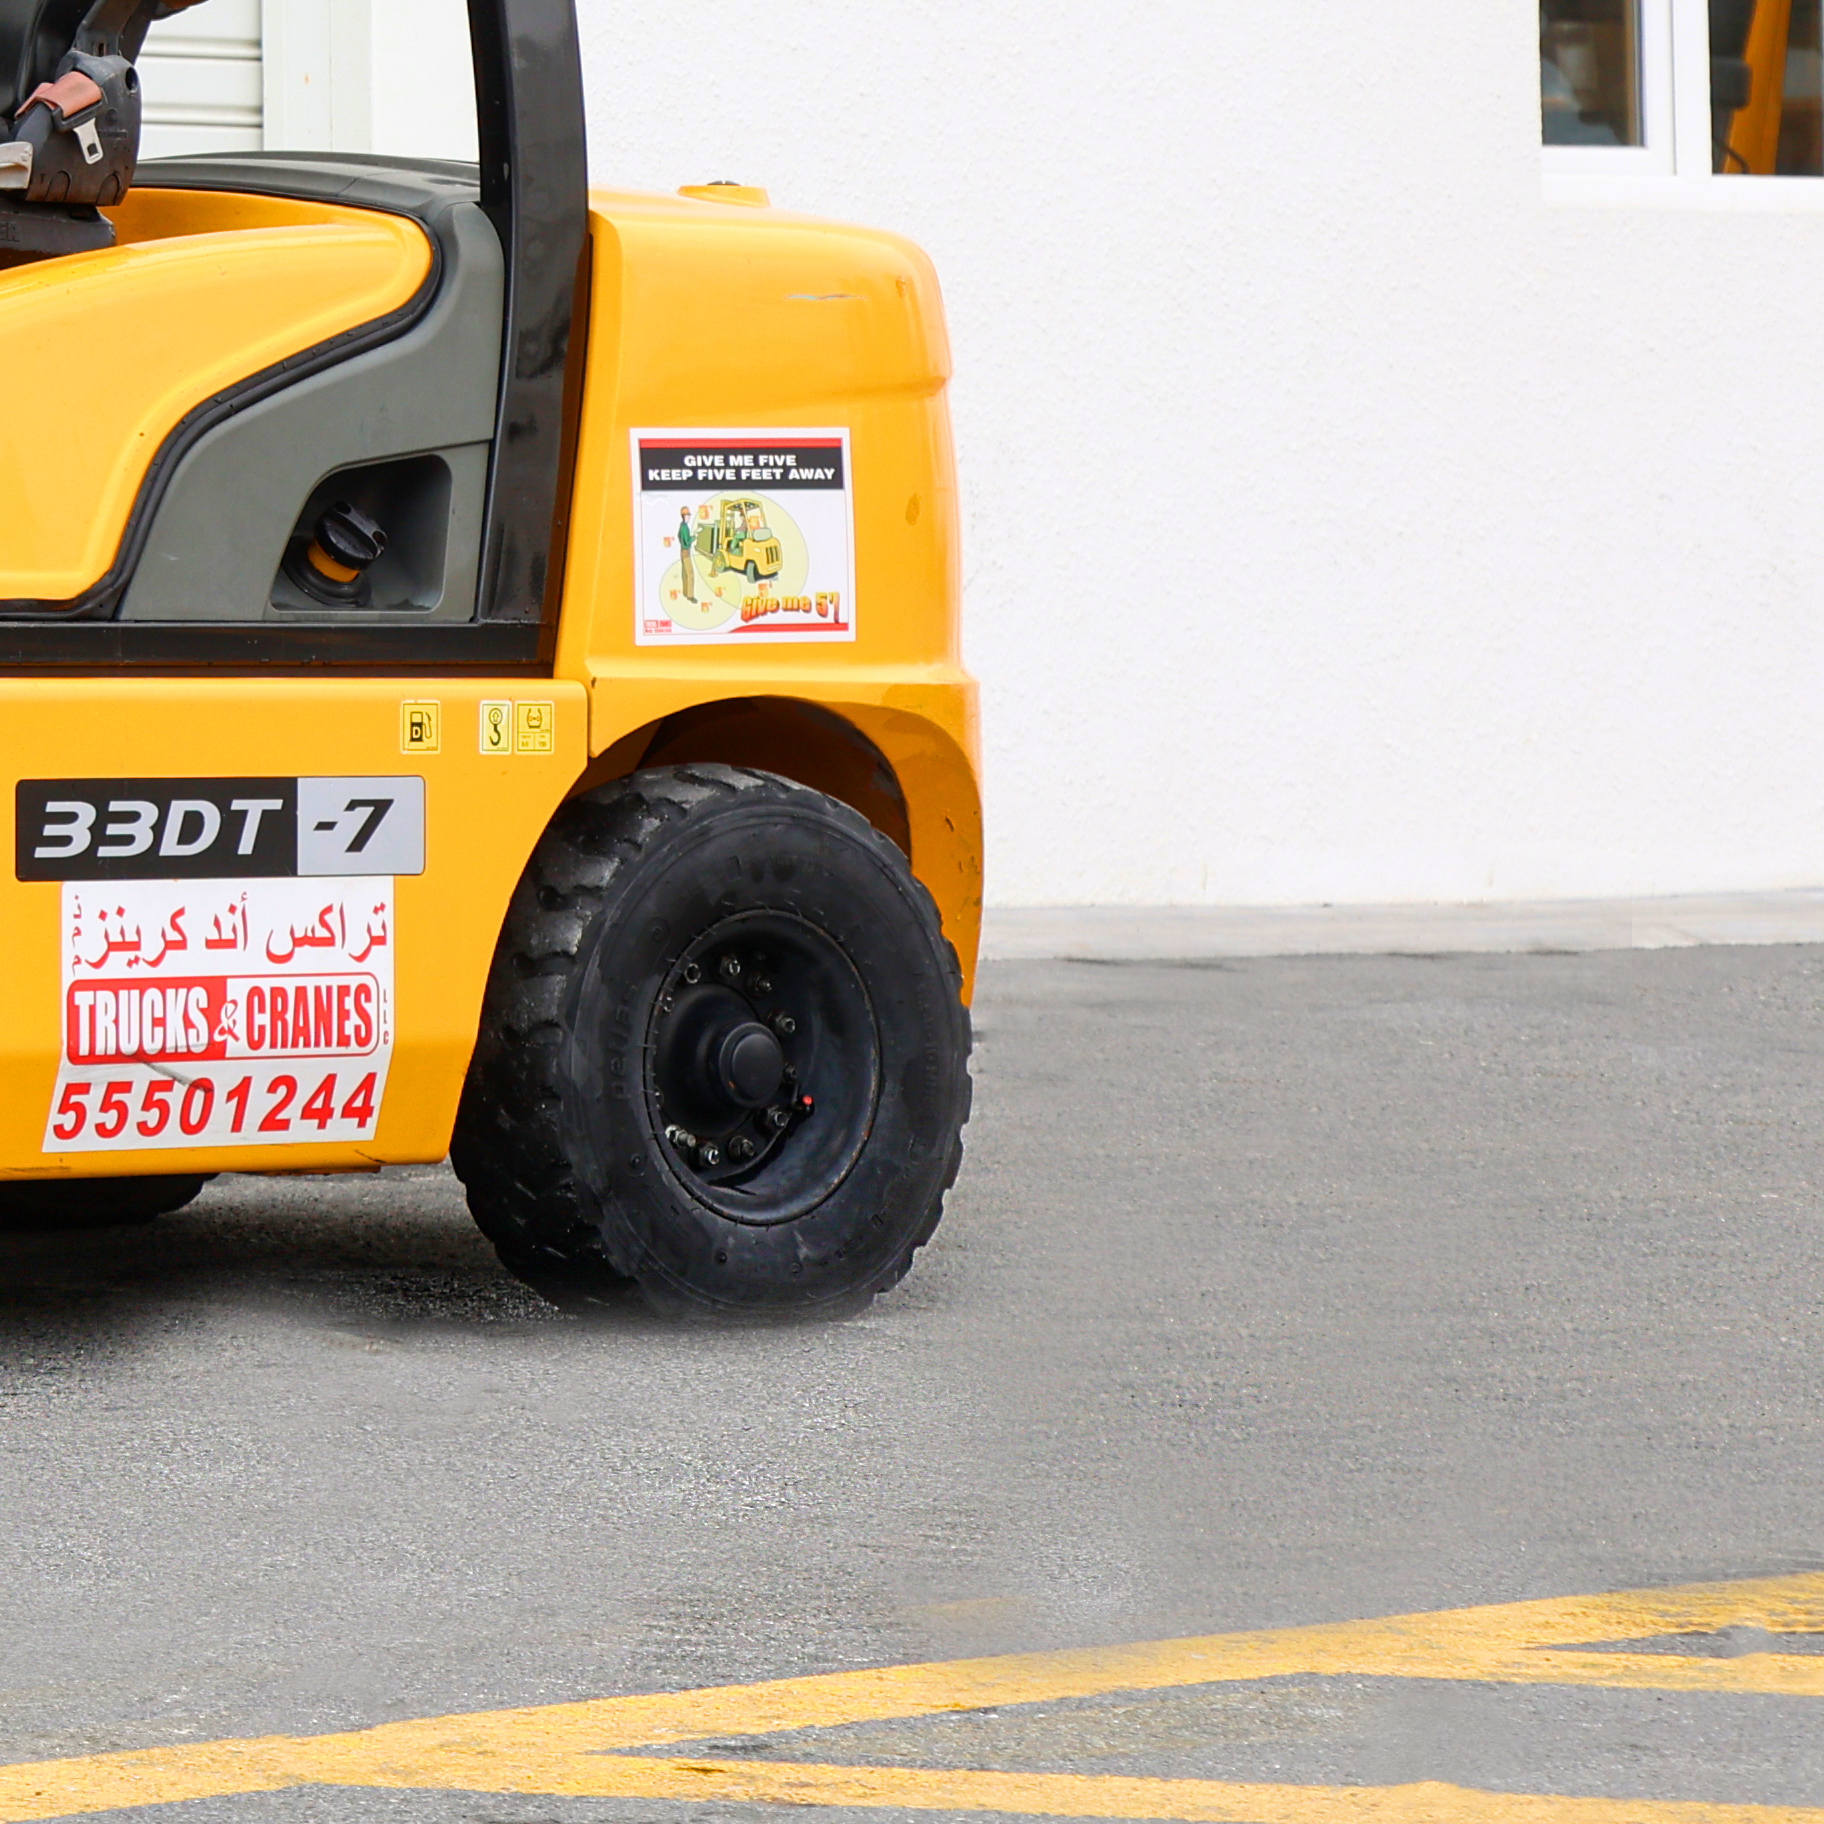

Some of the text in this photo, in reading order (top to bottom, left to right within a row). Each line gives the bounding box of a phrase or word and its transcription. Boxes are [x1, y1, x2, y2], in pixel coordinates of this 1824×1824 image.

[648, 468, 835, 481] KEEP FIVE FEET AWAY
[684, 455, 797, 467] GIVE ME FIVE
[781, 596, 812, 614] me
[34, 798, 284, 860] 33DT
[85, 891, 387, 969] تراكس أند كرينز
[74, 983, 372, 1056] TRUCKS & CRANES
[51, 1071, 378, 1141] 55501244
